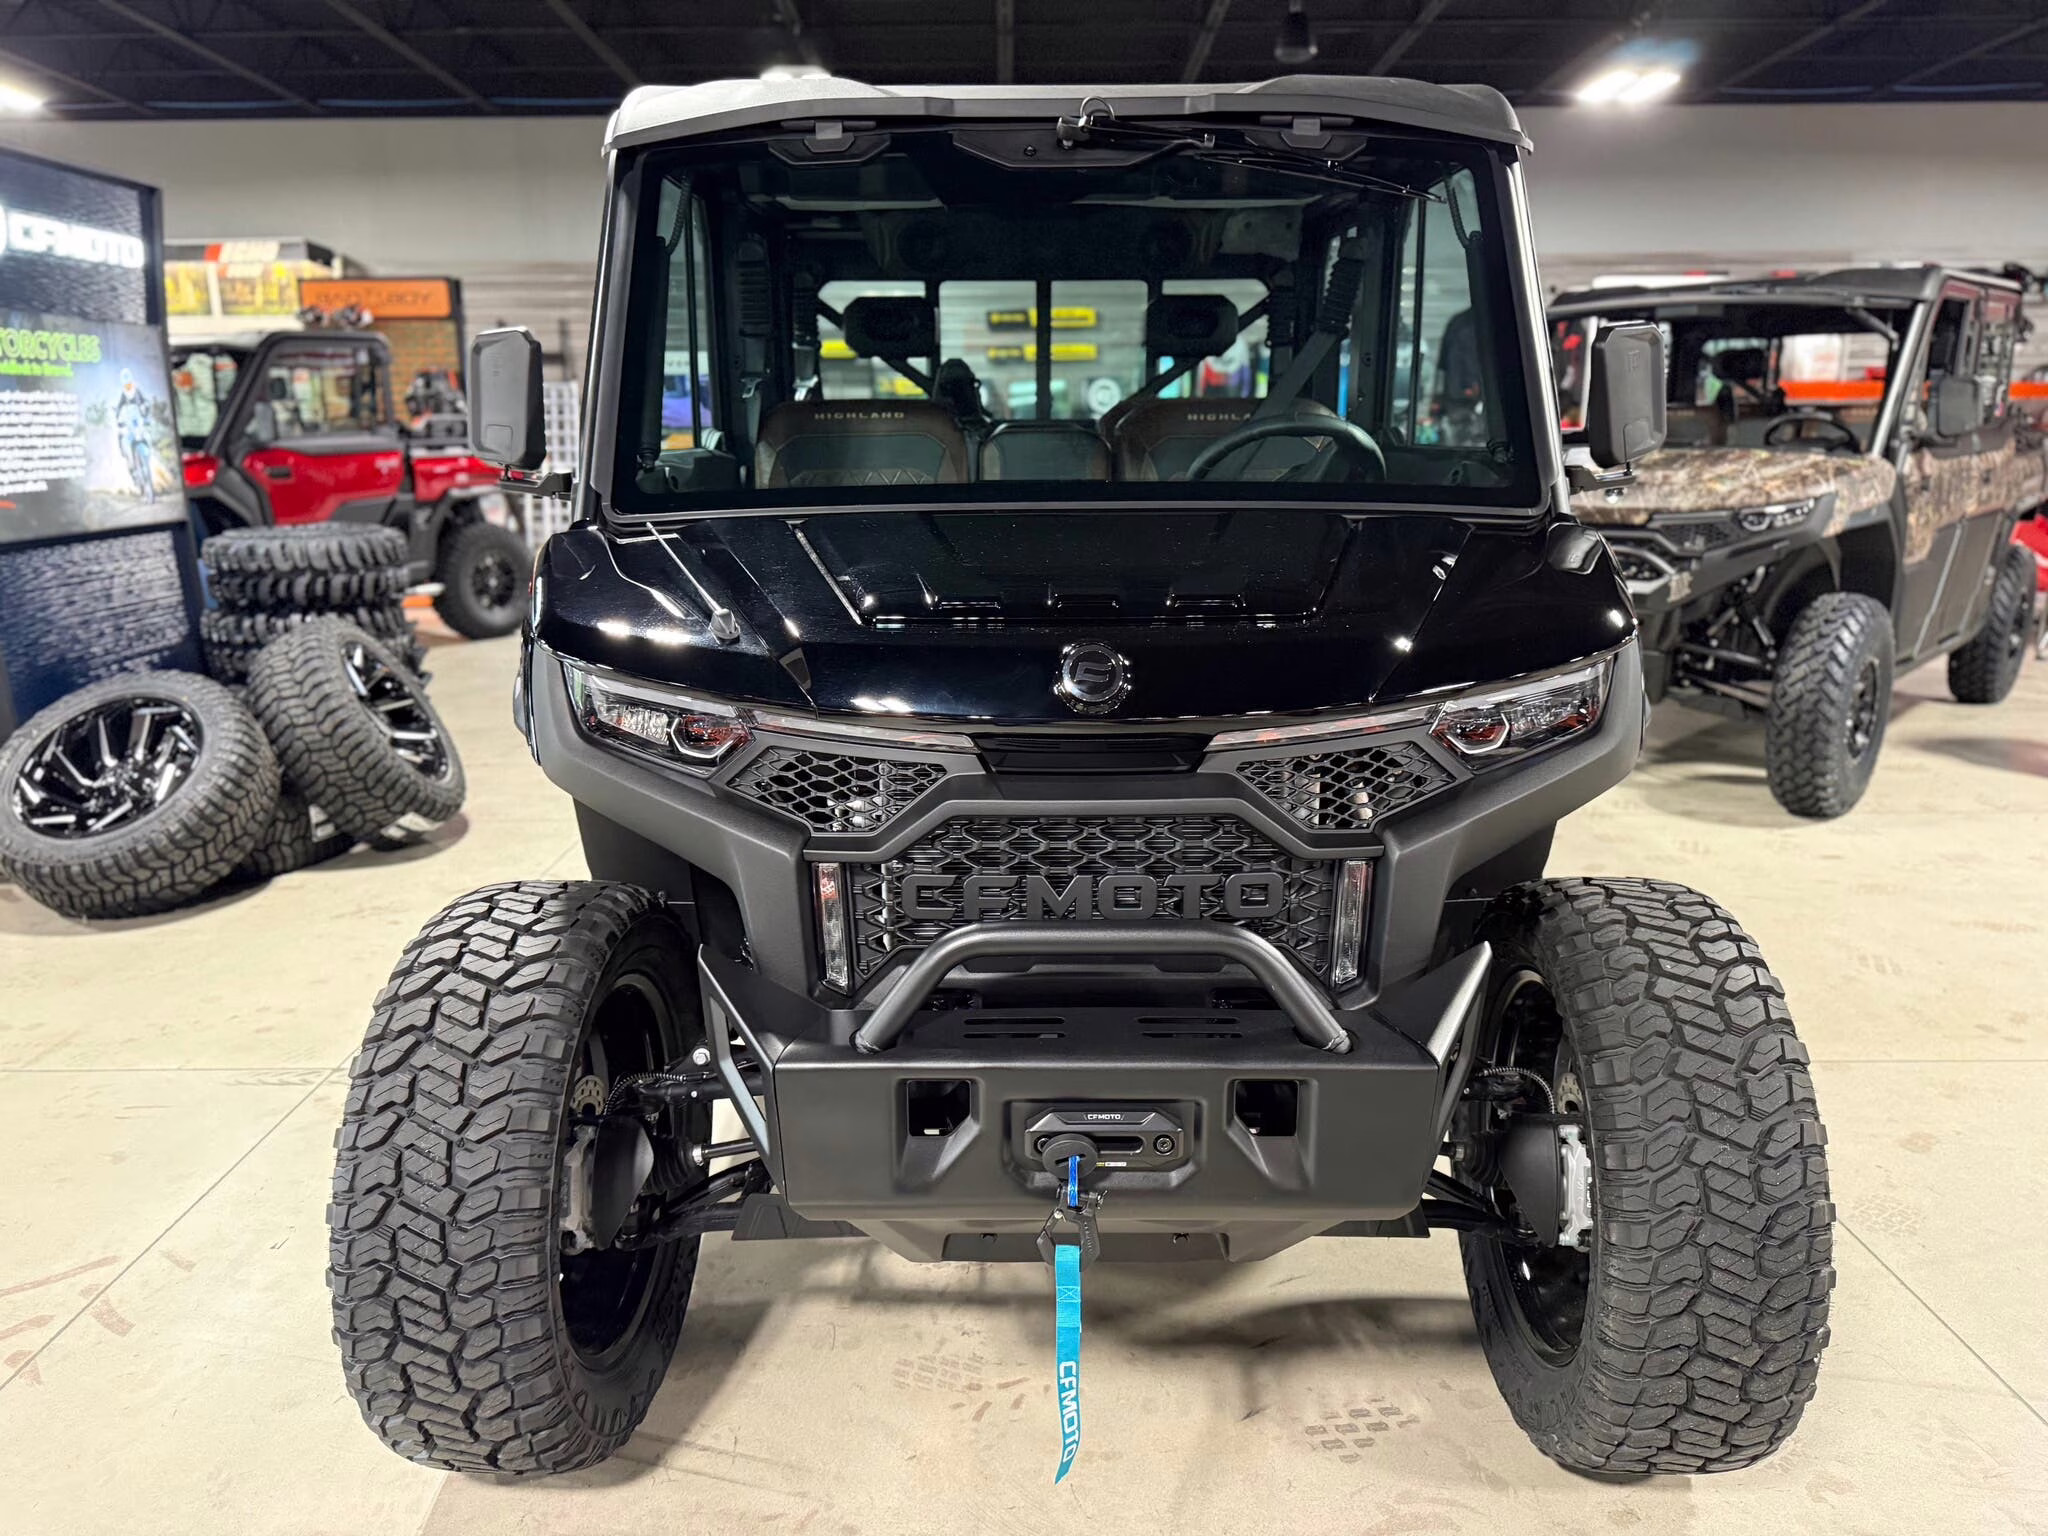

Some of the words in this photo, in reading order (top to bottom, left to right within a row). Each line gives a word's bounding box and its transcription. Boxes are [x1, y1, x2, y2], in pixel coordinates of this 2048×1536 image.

[814, 411, 905, 420] HIGHLAND
[900, 873, 1286, 919] CFMOTO
[1059, 1360, 1080, 1463] CFMOTO
